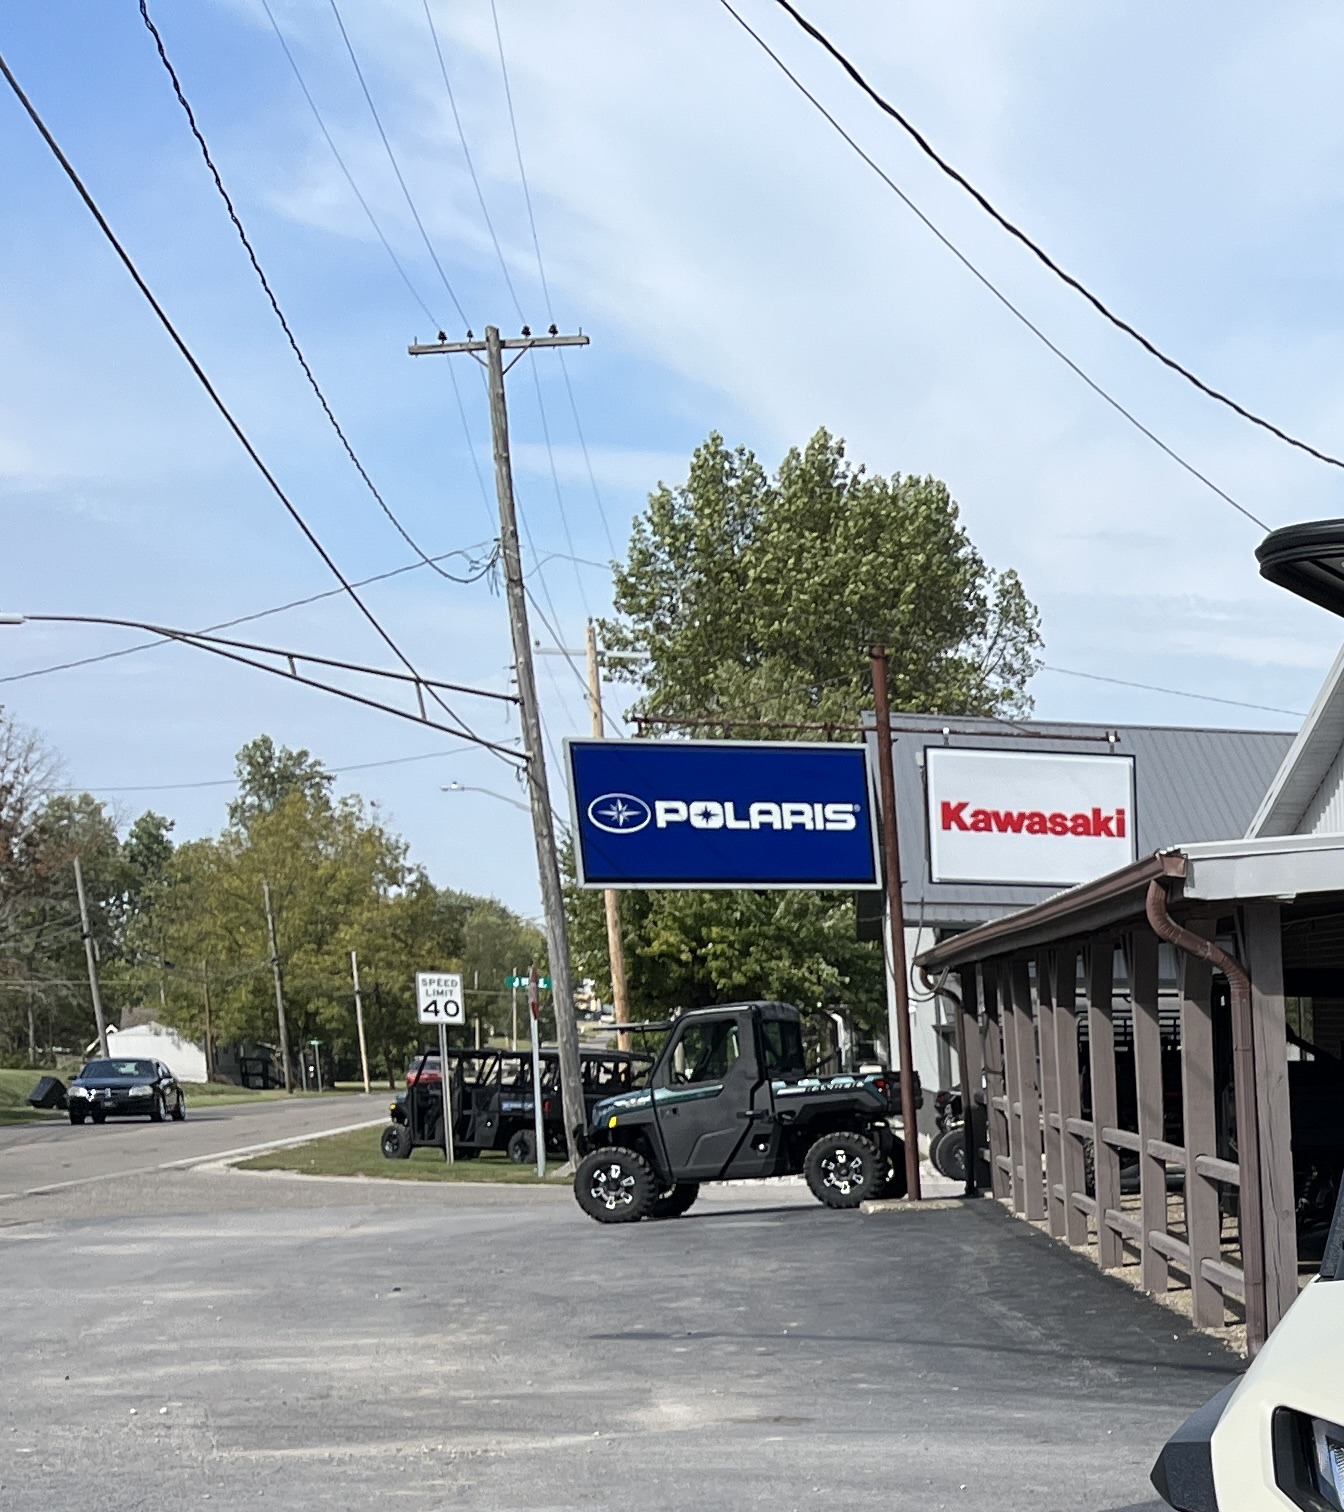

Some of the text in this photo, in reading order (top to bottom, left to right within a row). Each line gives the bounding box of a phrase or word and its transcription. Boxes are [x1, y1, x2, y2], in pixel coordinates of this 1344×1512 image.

[654, 799, 856, 831] POLARIS
[940, 800, 1126, 838] Kawasaki
[421, 977, 458, 988] SPEED
[425, 989, 454, 998] LIMIT
[422, 999, 460, 1018] 40
